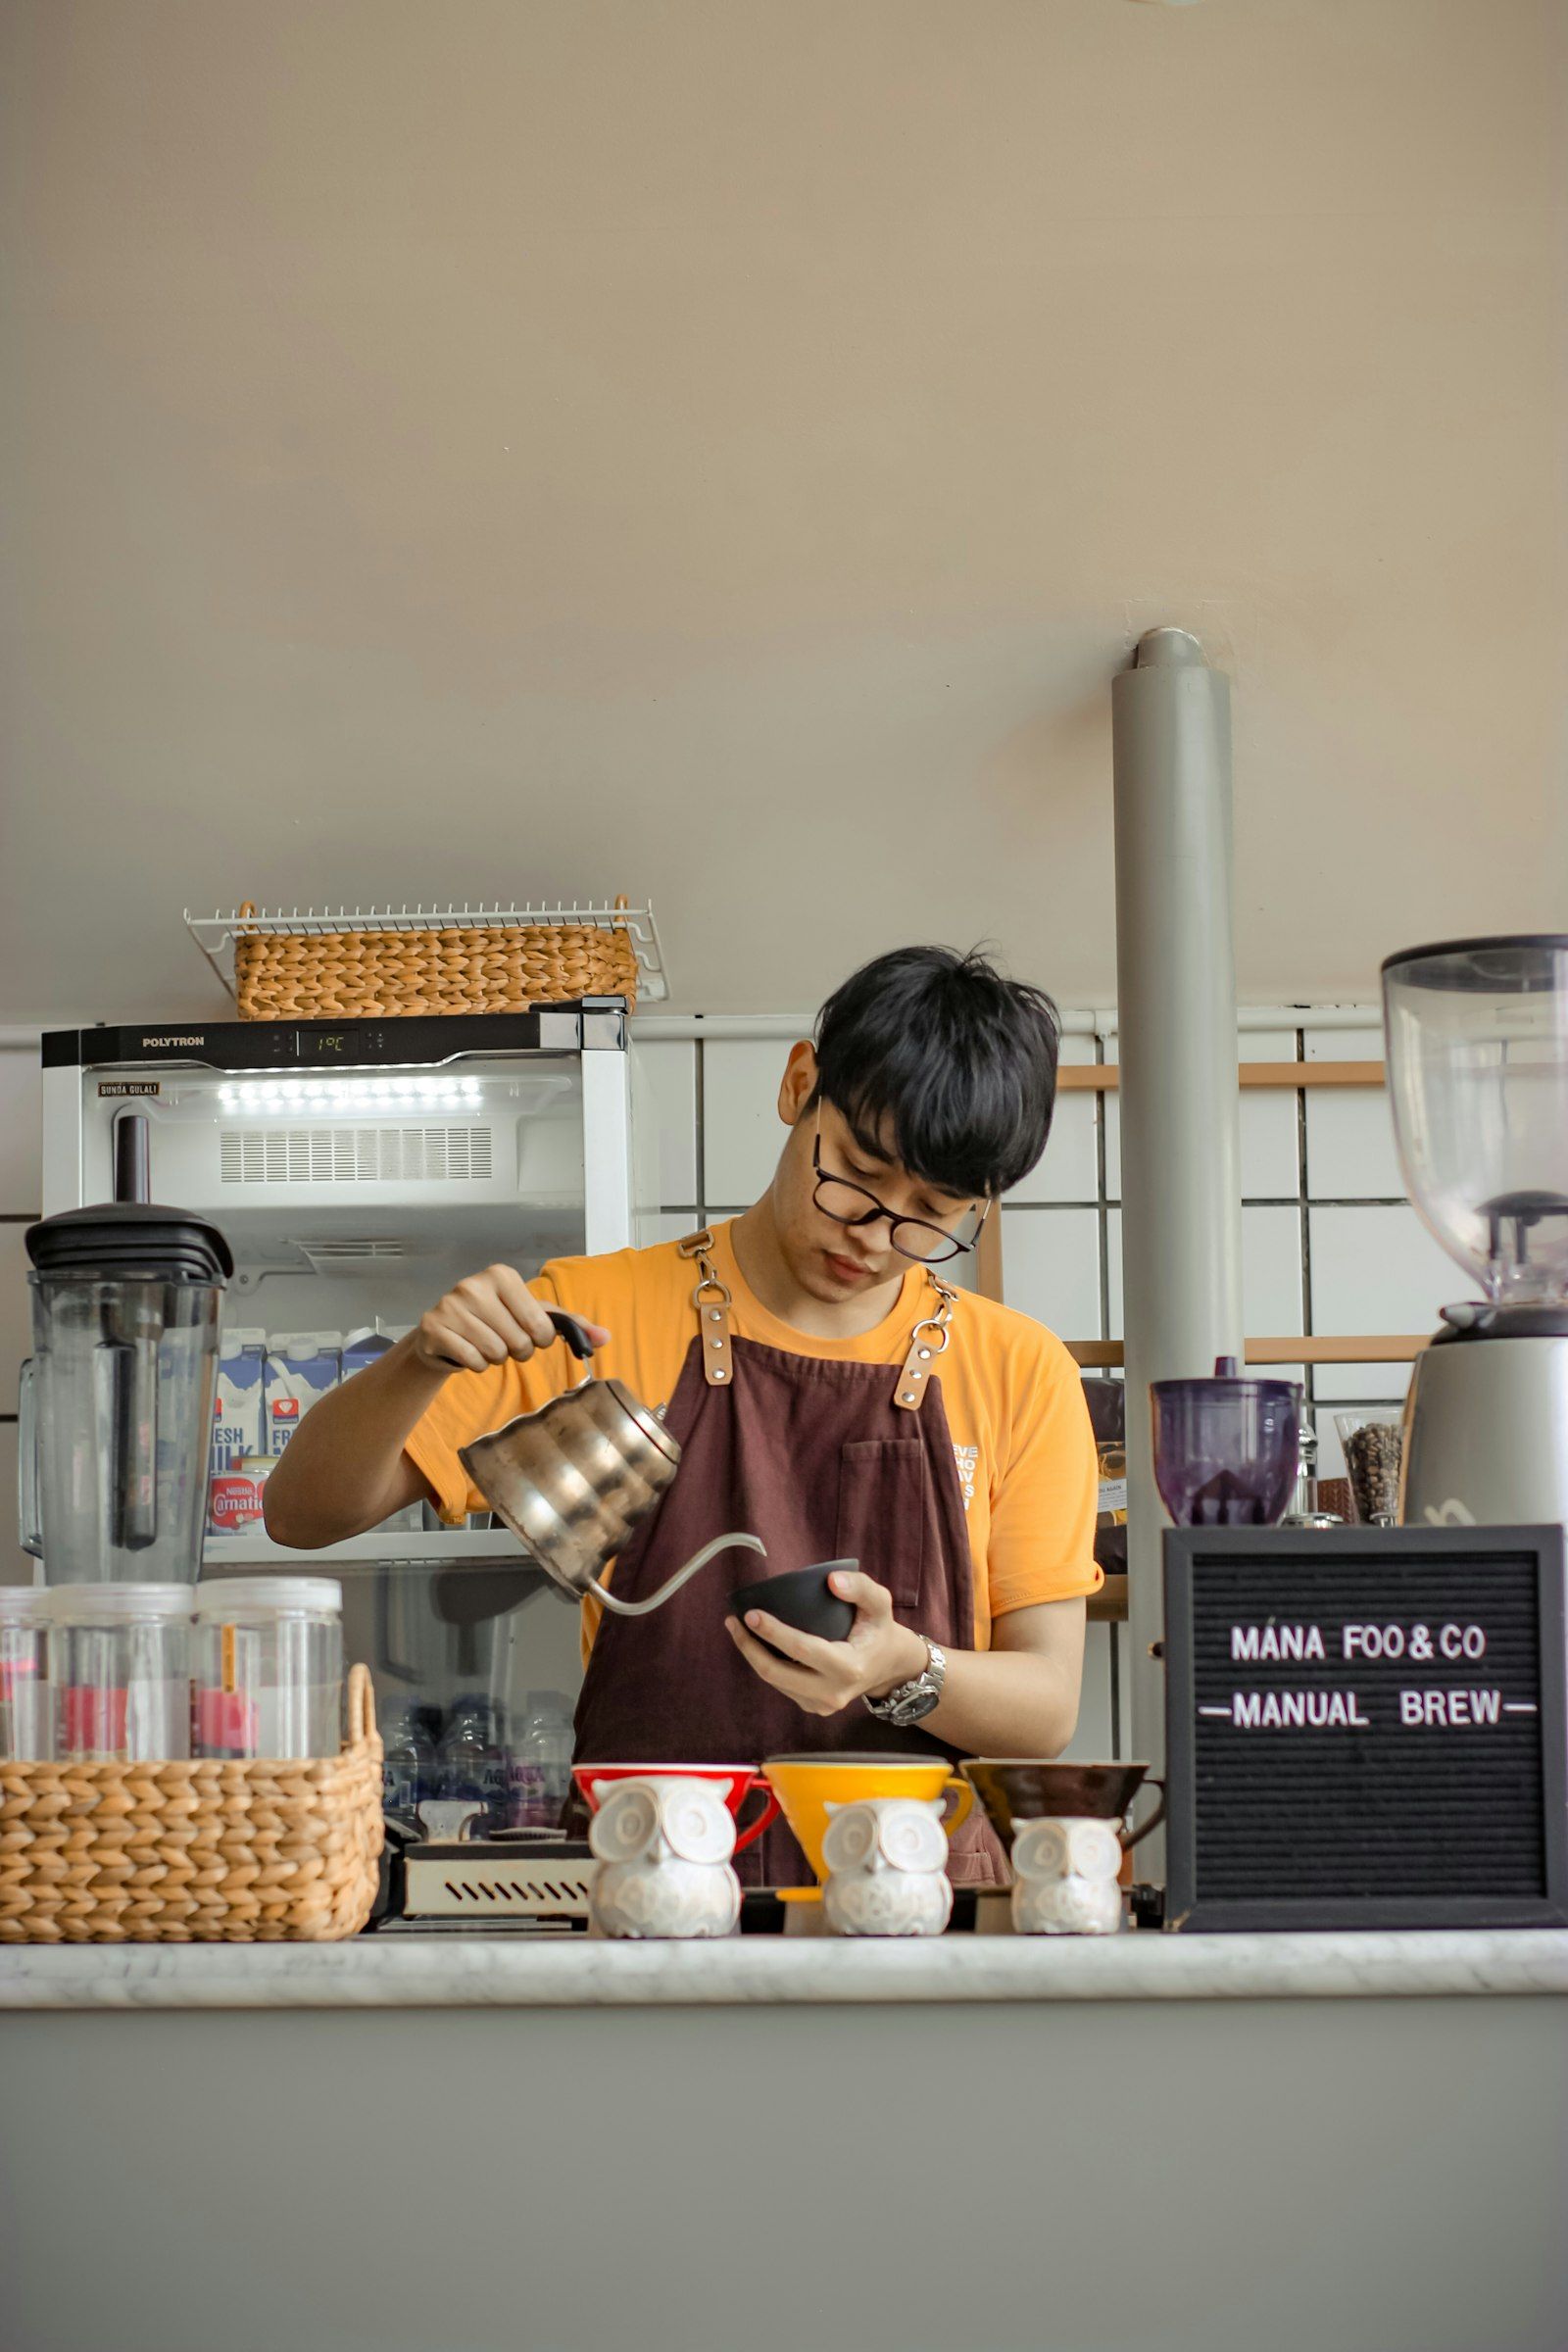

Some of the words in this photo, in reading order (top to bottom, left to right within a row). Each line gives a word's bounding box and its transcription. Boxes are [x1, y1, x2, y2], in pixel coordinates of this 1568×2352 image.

[142, 1037, 205, 1048] POLYTRON
[100, 1084, 126, 1095] SUNDA
[129, 1084, 157, 1095] GULALI
[272, 1429, 296, 1446] FR
[1231, 1625, 1325, 1660] MANA
